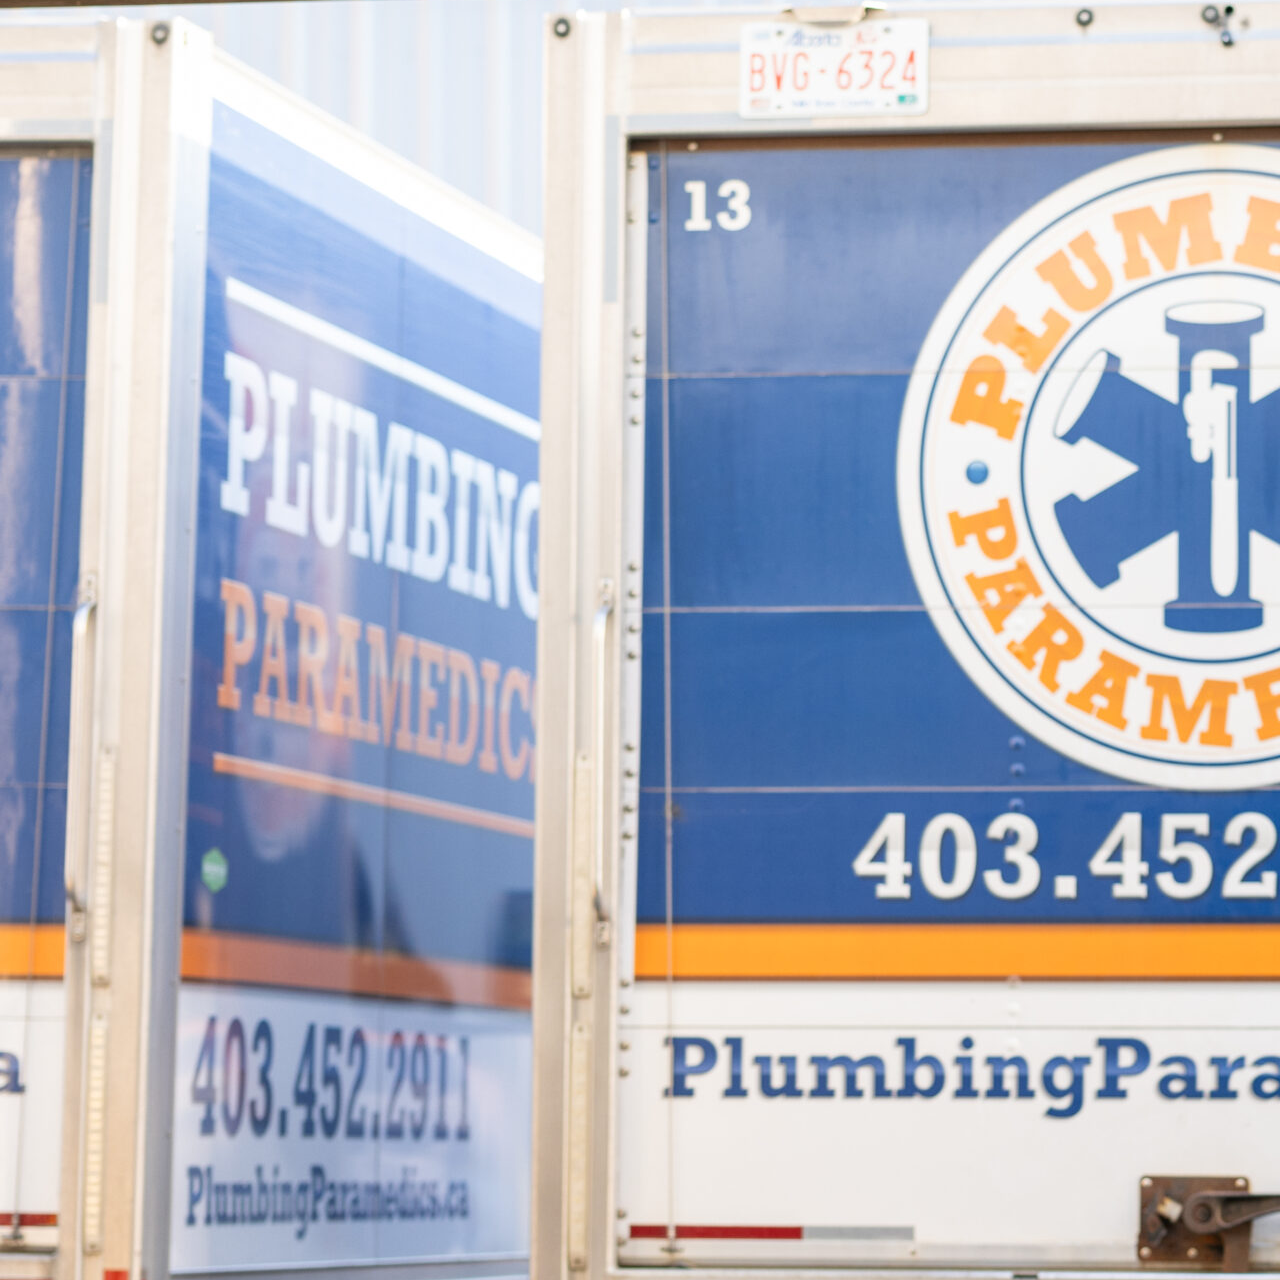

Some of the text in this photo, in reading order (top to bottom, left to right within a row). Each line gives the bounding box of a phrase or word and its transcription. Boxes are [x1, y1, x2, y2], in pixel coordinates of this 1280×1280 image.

[750, 49, 917, 93] BVG-6324
[684, 179, 752, 231] 13
[217, 577, 538, 784] PARAMEDIC
[191, 1015, 470, 1141] 403.452.2911
